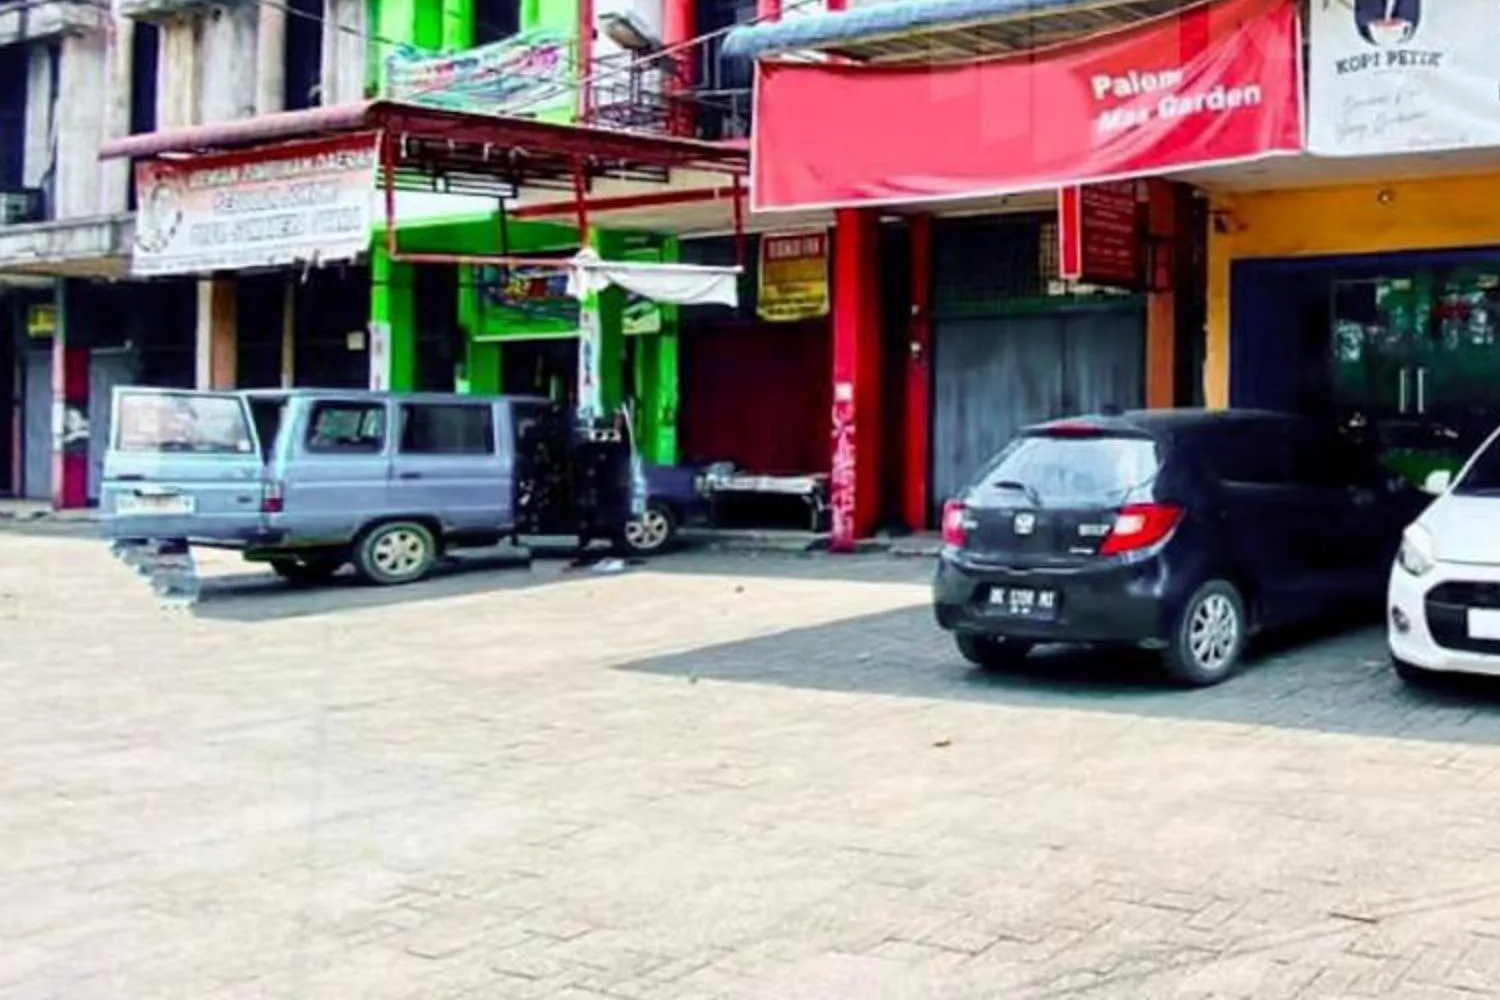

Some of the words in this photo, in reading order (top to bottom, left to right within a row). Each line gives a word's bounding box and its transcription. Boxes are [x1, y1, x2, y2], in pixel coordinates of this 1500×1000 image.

[1336, 51, 1381, 75] KOPI
[1386, 49, 1444, 68] PETIK
[1157, 84, 1262, 120] Garden
